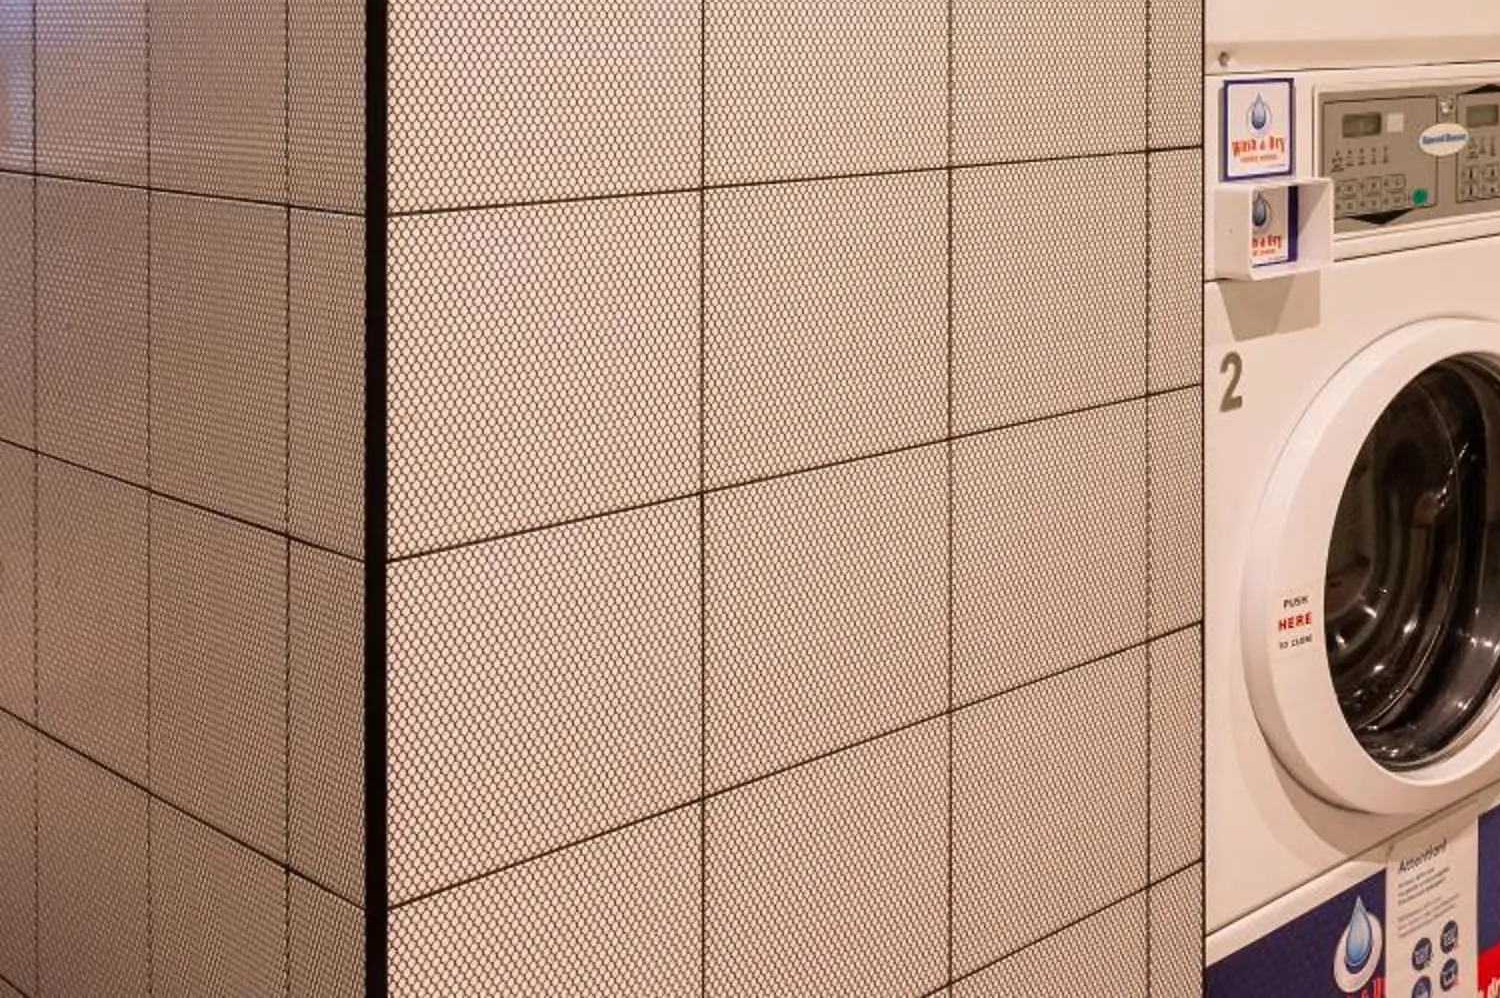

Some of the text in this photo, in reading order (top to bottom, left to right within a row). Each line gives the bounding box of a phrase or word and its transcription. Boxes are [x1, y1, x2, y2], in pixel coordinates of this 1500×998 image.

[1231, 138, 1258, 158] Wash
[1269, 135, 1286, 153] Dry
[1219, 352, 1244, 412] 2
[1283, 596, 1309, 609] PUSH
[1278, 611, 1313, 632] HERE
